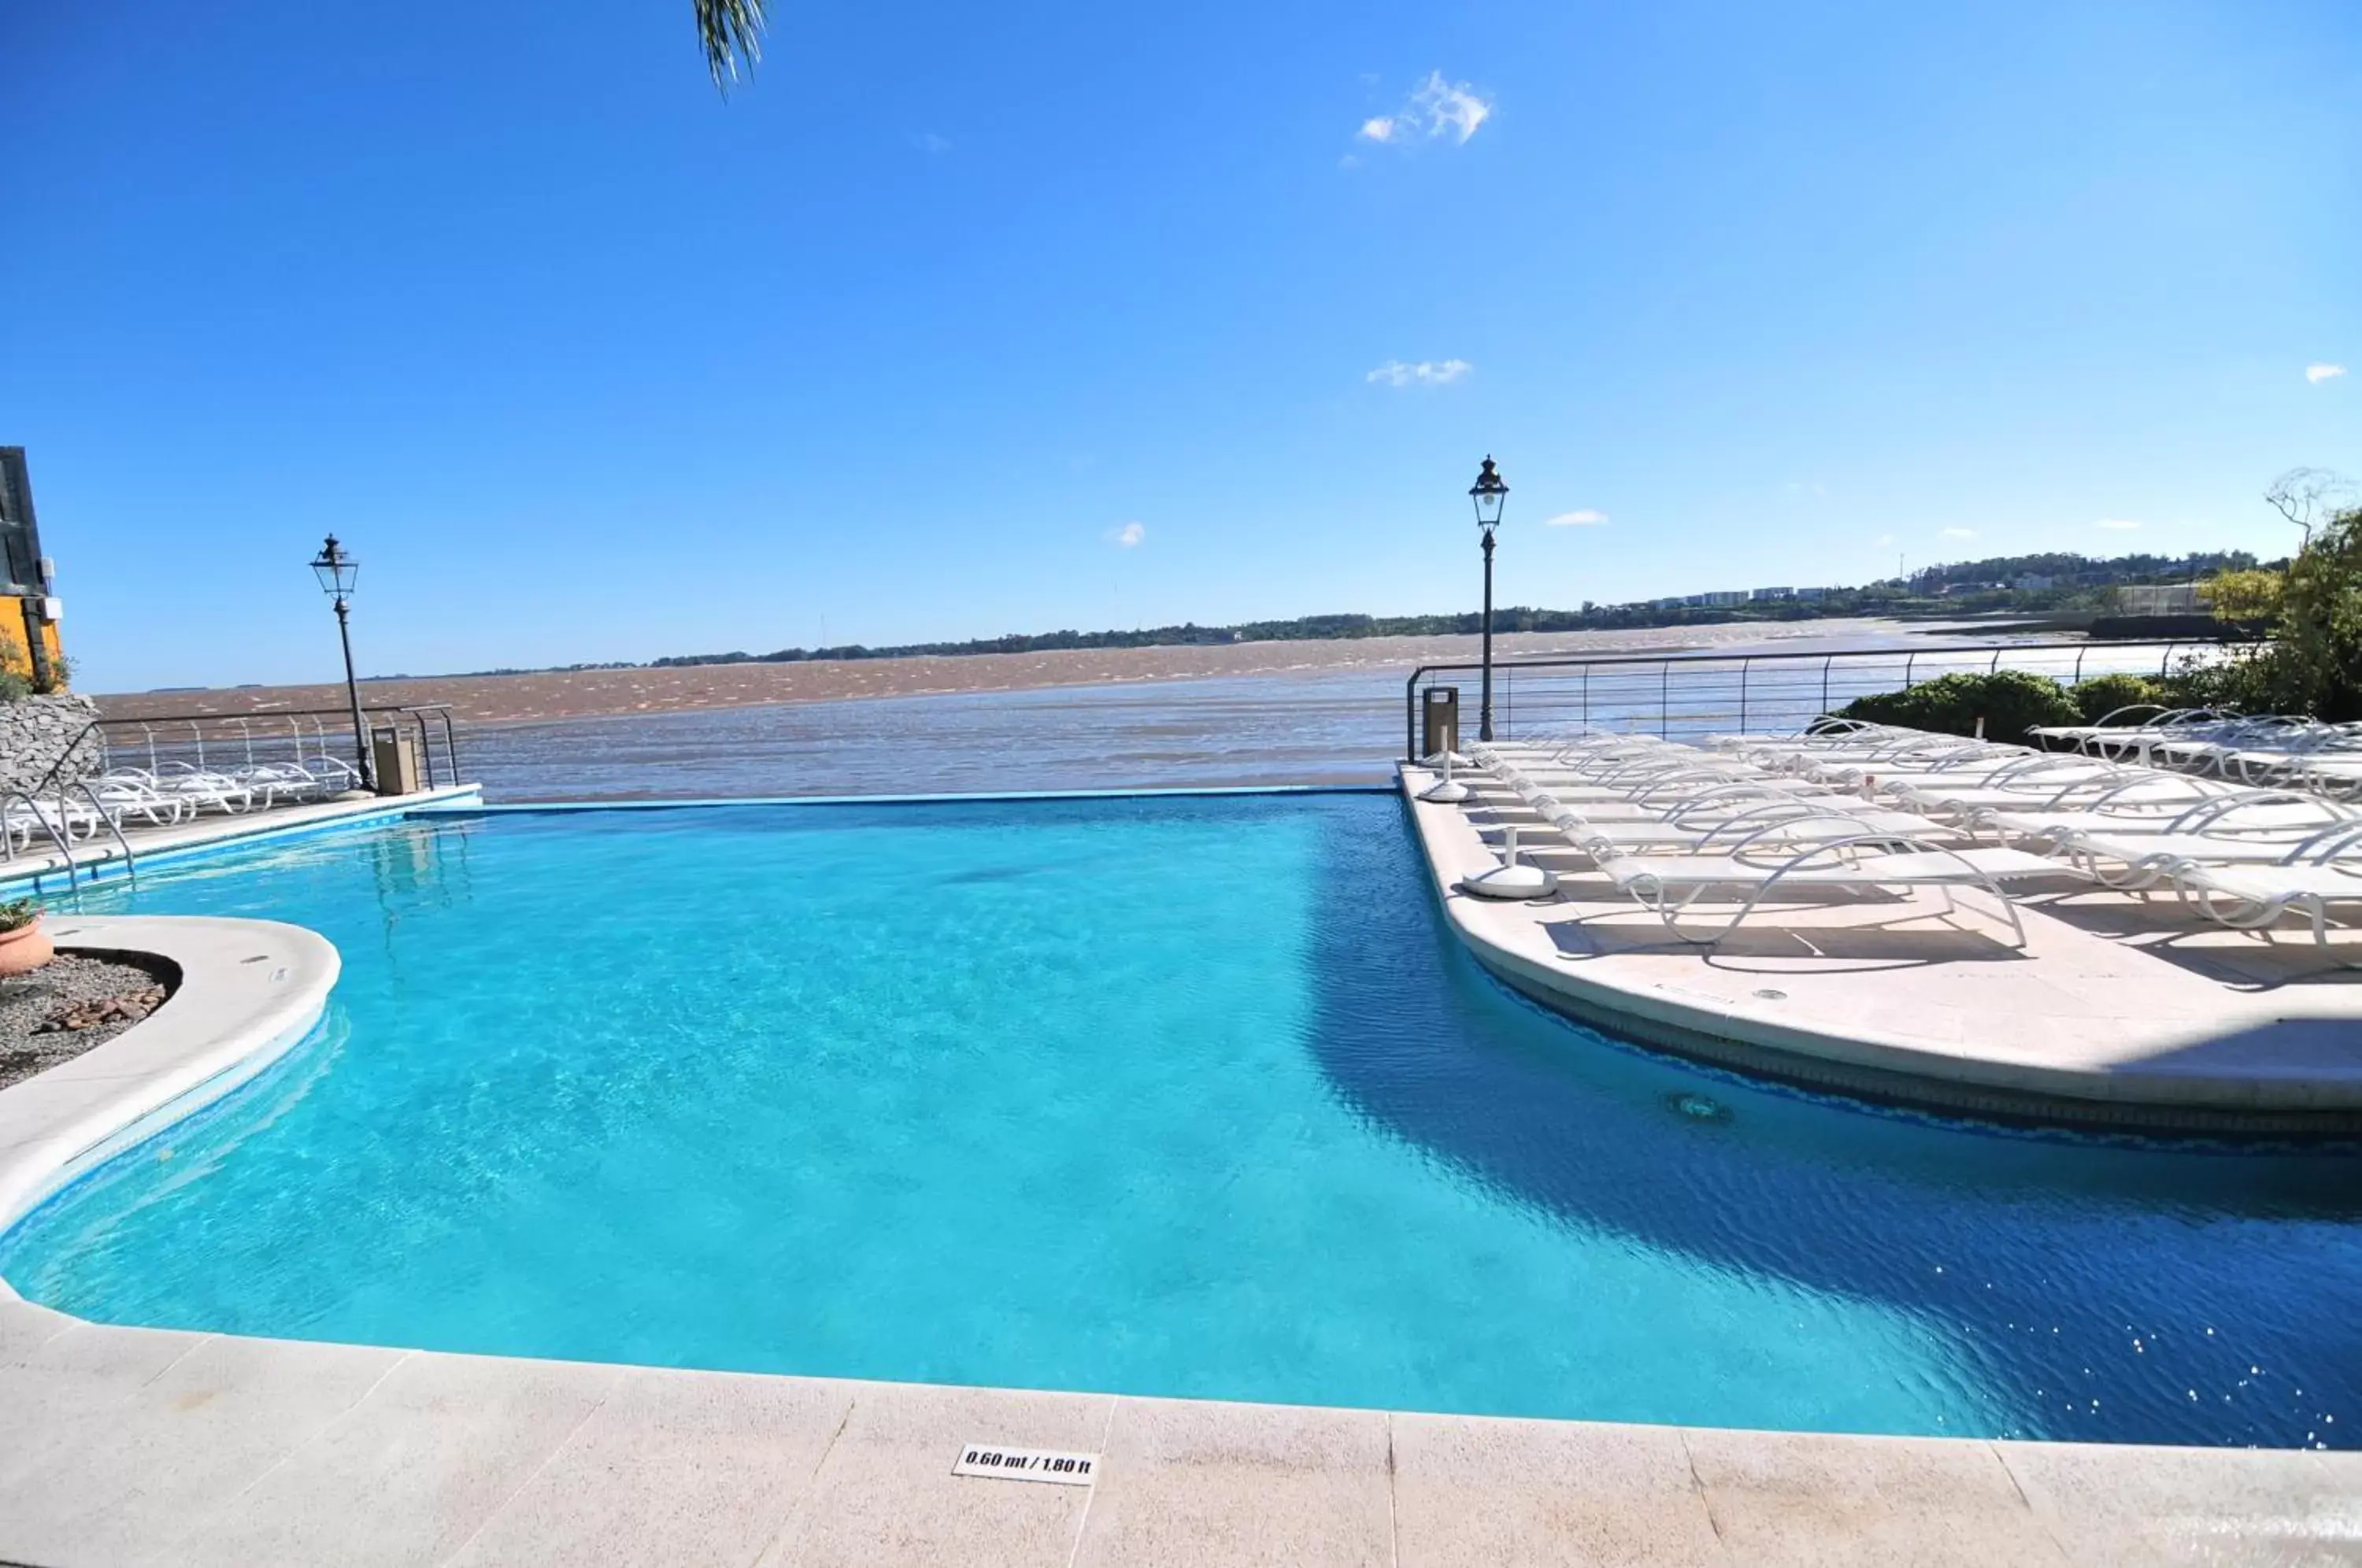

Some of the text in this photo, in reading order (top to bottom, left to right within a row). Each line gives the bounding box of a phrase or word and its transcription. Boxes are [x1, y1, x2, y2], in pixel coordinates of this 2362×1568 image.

[965, 1451, 1091, 1474] 0.60 mt / 1.80 ft
